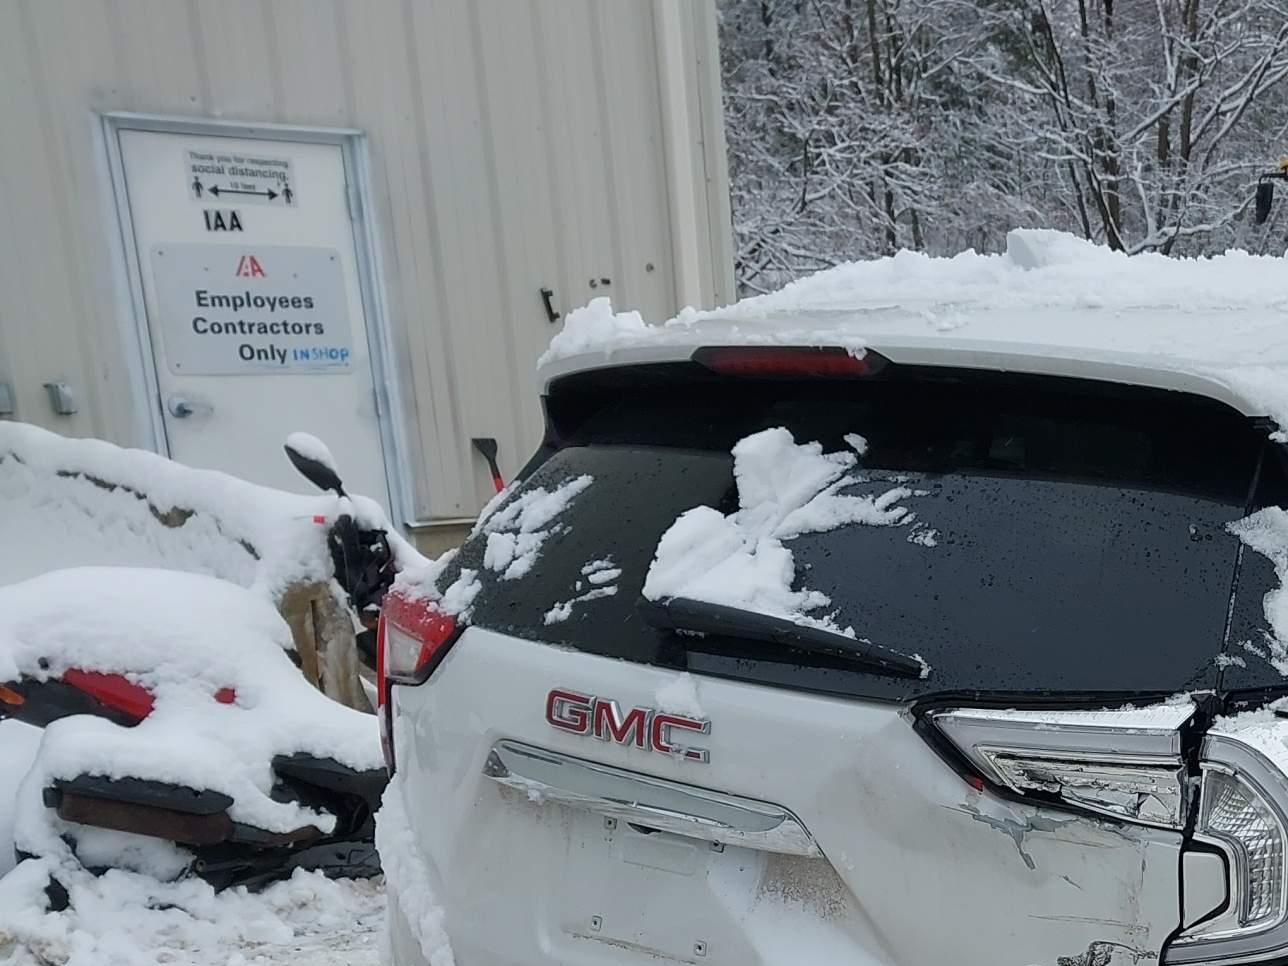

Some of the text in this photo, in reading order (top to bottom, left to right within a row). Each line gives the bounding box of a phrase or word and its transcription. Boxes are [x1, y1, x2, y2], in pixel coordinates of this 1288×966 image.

[191, 164, 225, 174] social
[203, 209, 243, 231] IAA
[195, 290, 314, 312] Employees
[192, 317, 325, 336] Contractors
[238, 344, 288, 365] Only
[545, 687, 712, 764] GMC
